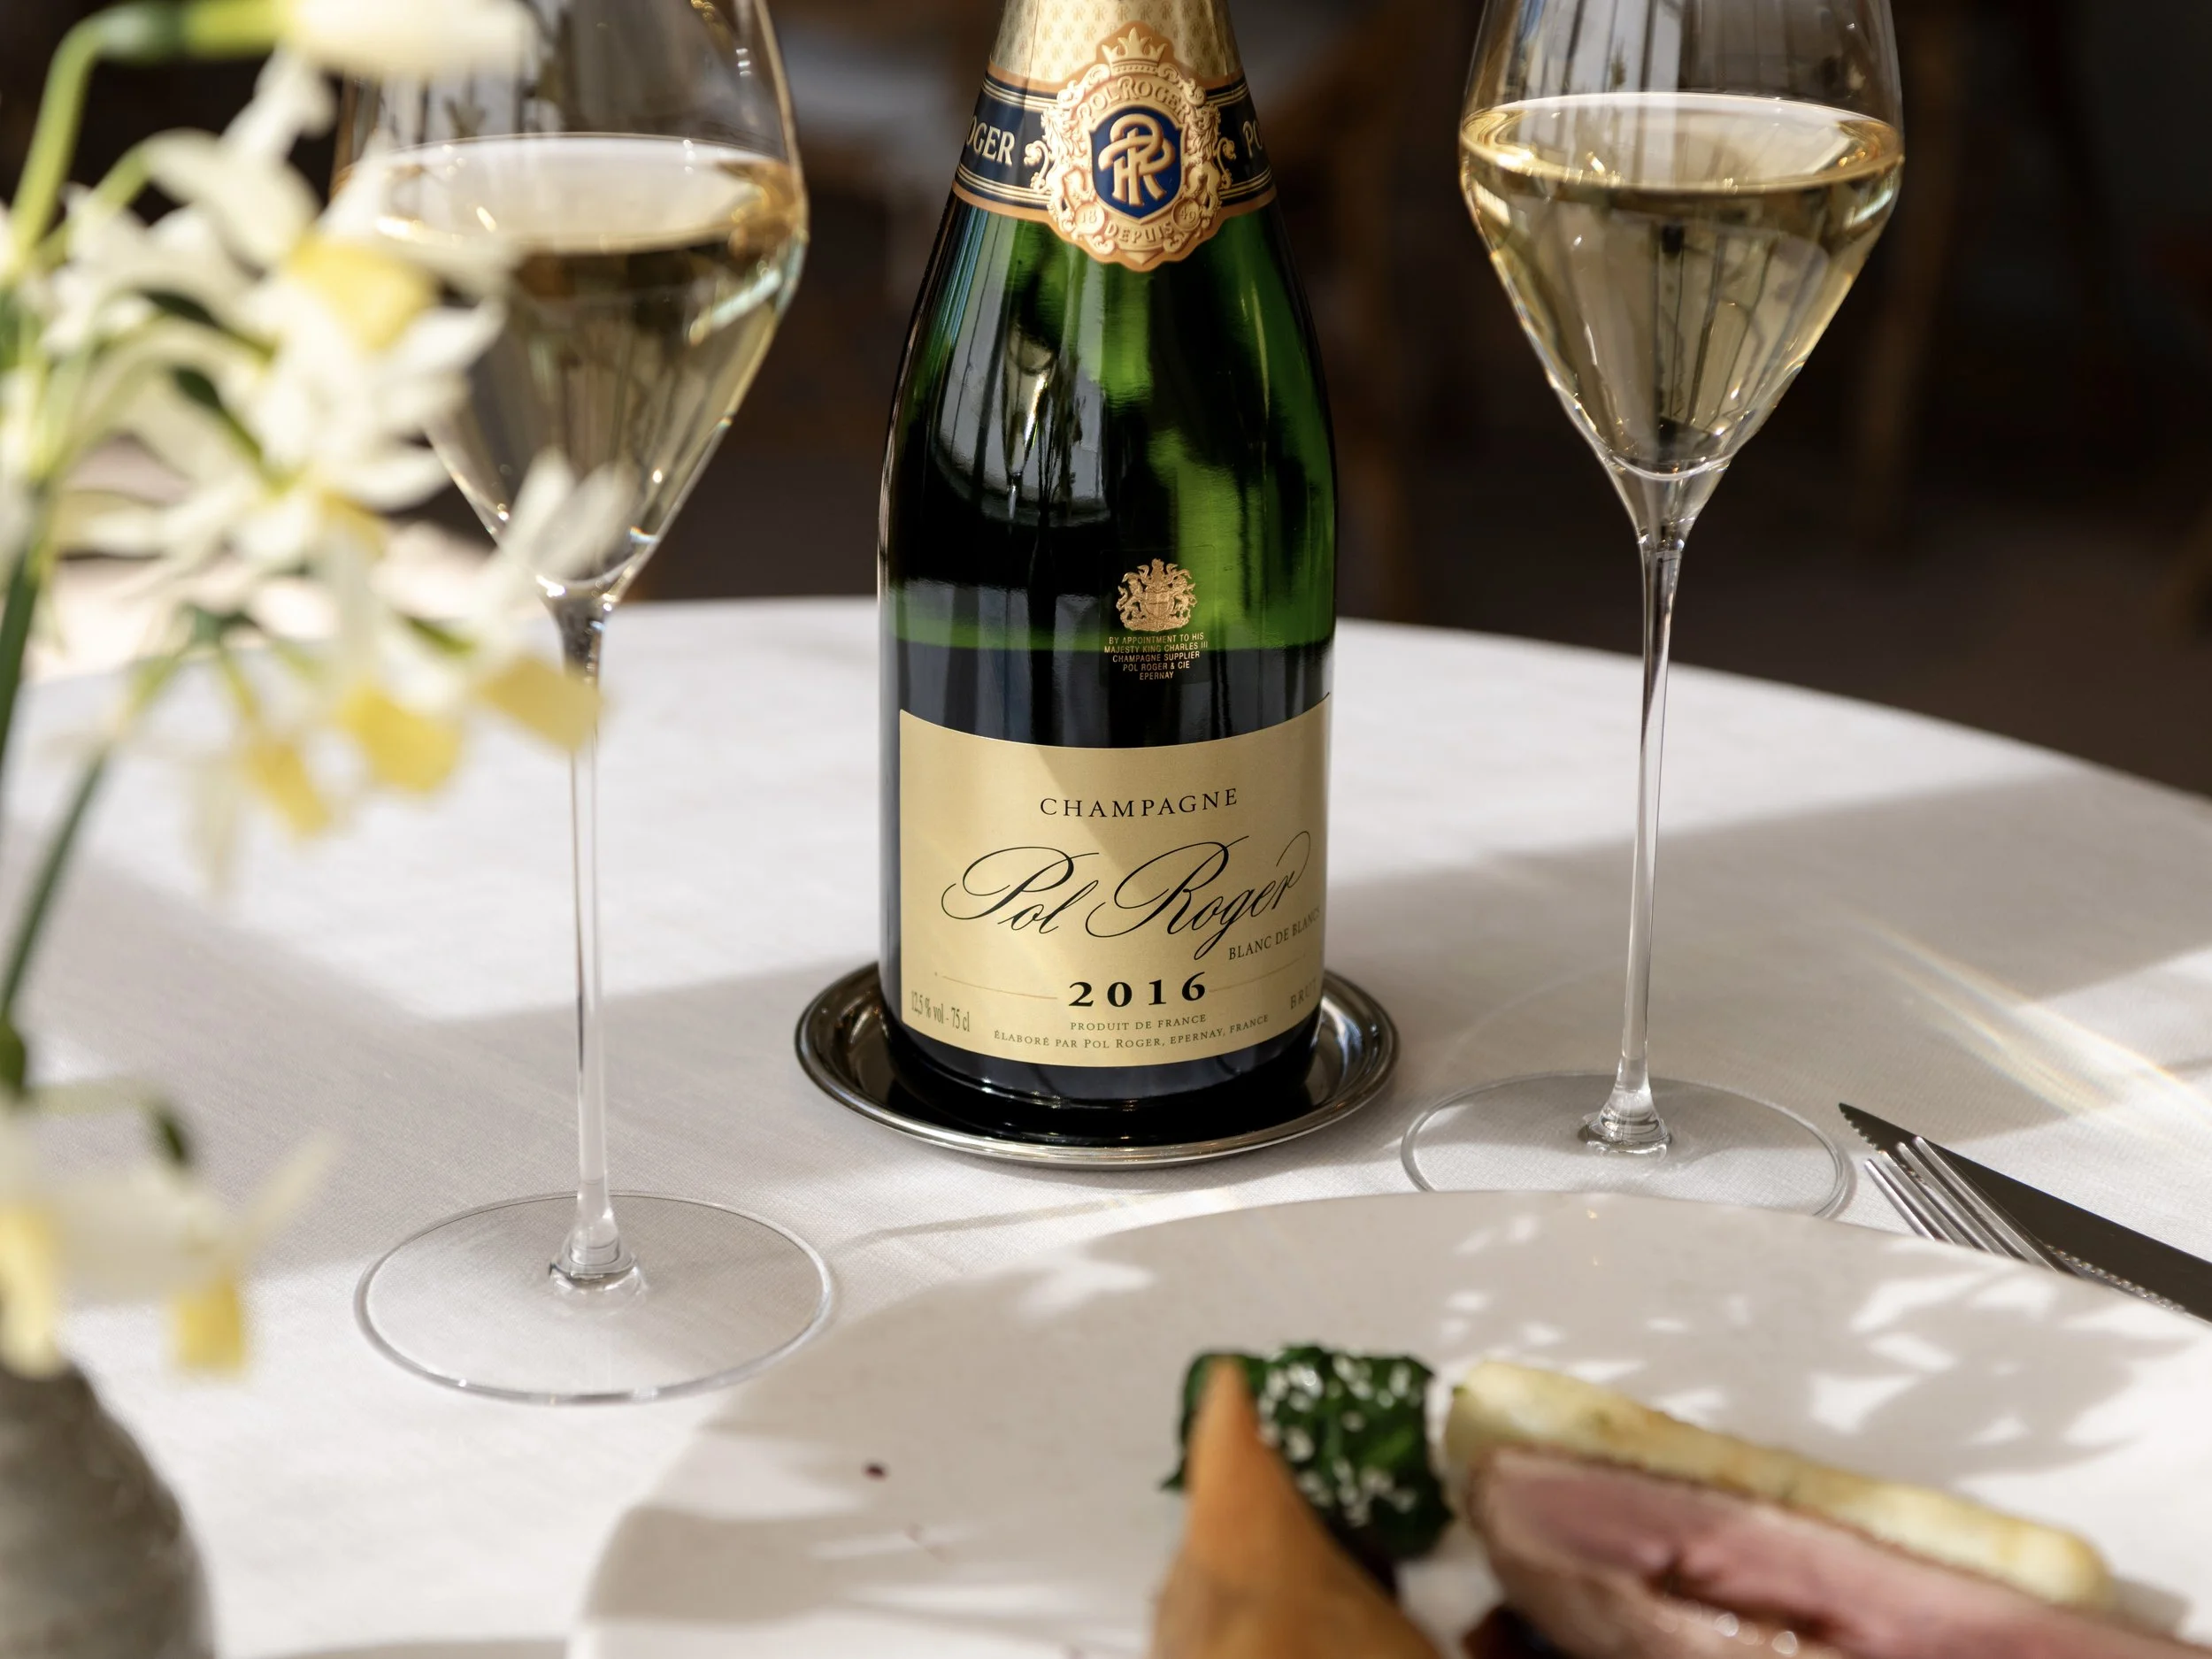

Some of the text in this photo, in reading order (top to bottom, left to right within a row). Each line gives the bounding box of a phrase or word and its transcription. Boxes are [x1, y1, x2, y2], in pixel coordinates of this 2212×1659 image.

[1077, 75, 1191, 122] POL ROGER
[1104, 220, 1175, 244] DEPUIS
[1104, 645, 1141, 654] MAJESTY
[1142, 644, 1162, 653] KING
[1164, 641, 1198, 652] CHARLES
[1122, 634, 1177, 645] APPOINTMENT
[1179, 634, 1189, 642] TO
[1192, 632, 1204, 641] HIS
[1112, 650, 1200, 663] CHAMPAGNE SUPPLIER
[1141, 662, 1168, 671] ROGER
[1140, 672, 1174, 680] EPERNAY
[1040, 787, 1238, 818] CHAMPAGNE
[941, 831, 1311, 961] Pol Roger
[1228, 936, 1272, 960] BLANC
[1275, 928, 1289, 946] DE
[1069, 972, 1206, 1008] 2016
[1290, 977, 1317, 1010] BRUT
[925, 997, 932, 1019] %
[933, 1002, 944, 1024] vol
[951, 1006, 961, 1029] 75
[962, 1010, 971, 1033] cl
[1071, 1014, 1207, 1031] PRODUIT DE FRANCE
[994, 1030, 1050, 1046] ÉLABORÉ
[1056, 1039, 1078, 1048] PAR
[1084, 1039, 1110, 1048] POL
[1170, 1027, 1225, 1044] EPERNAY,
[1230, 1014, 1269, 1034] FRANCE
